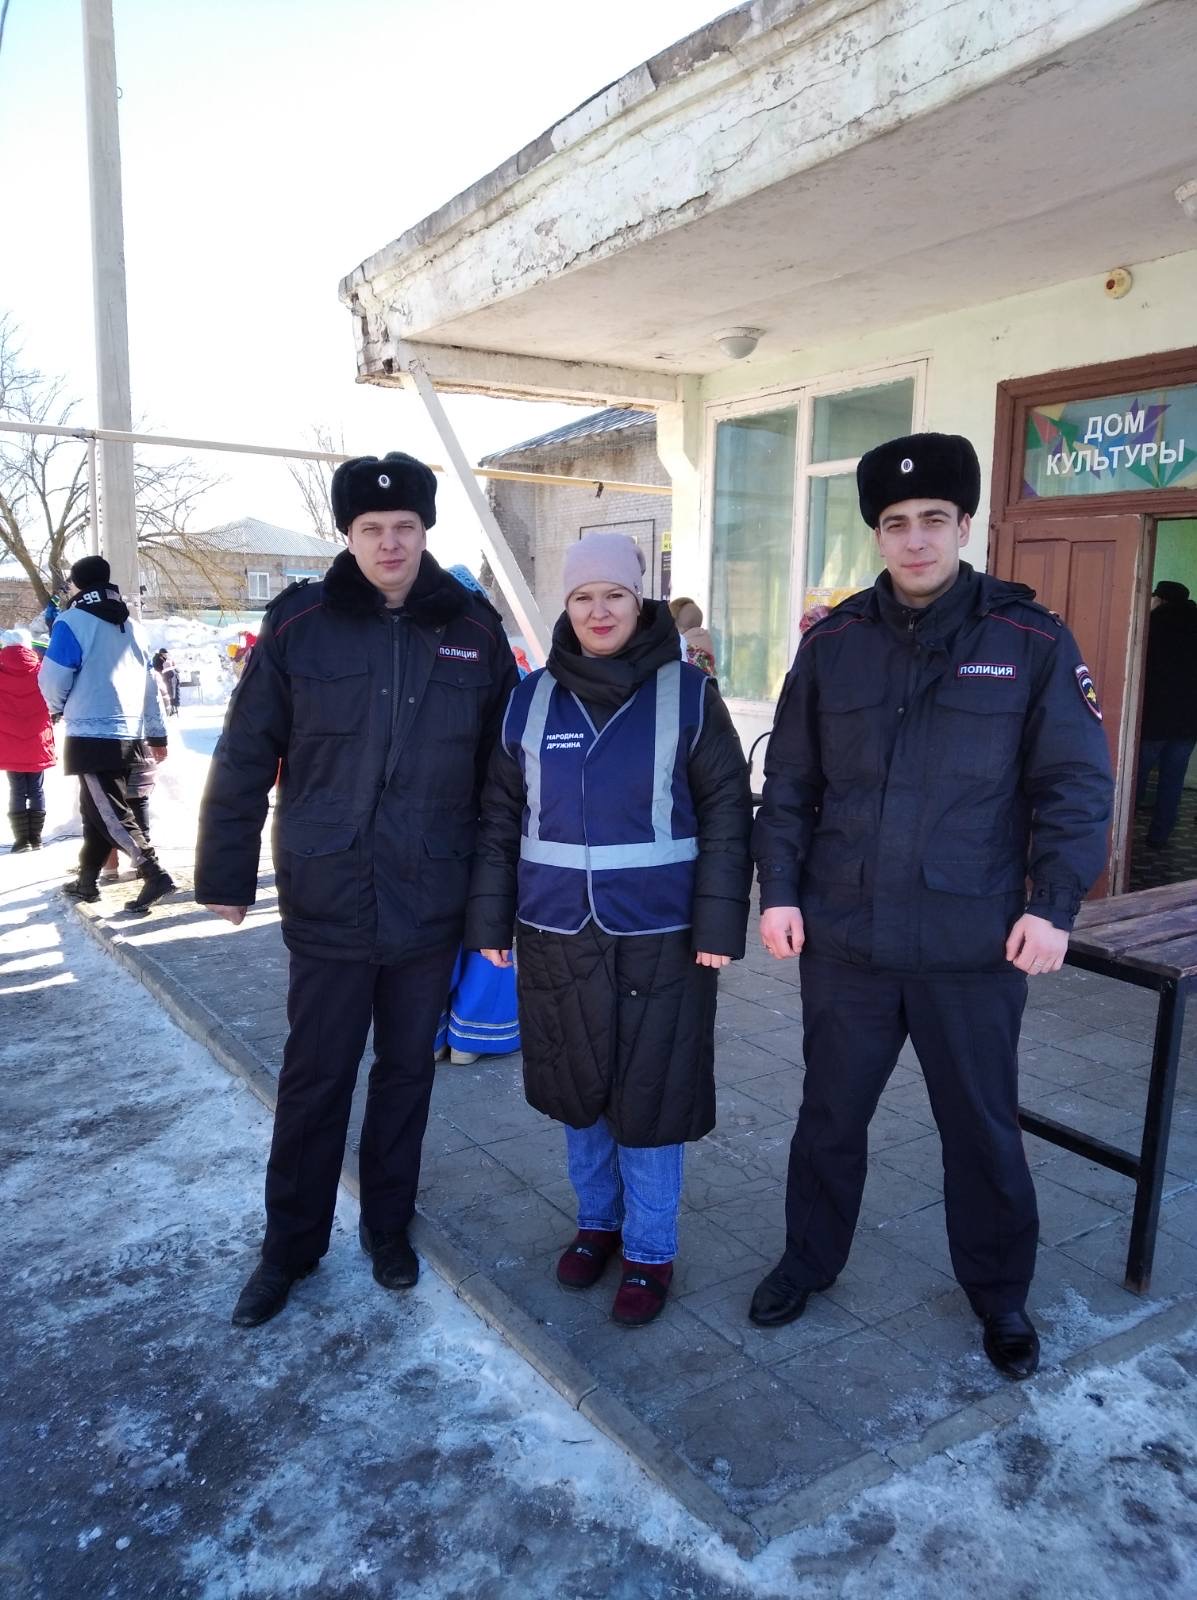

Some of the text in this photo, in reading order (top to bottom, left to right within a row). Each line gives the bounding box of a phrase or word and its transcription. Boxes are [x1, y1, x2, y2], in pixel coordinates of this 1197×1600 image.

[1084, 410, 1145, 443] ДОМ
[1046, 439, 1185, 476] КУЛЬТУРЫ
[439, 647, 478, 659] ПОЛИЦИЯ
[959, 665, 1013, 676] ПОЛИЦИЯ
[546, 733, 584, 741] НАРОДНАЯ
[546, 741, 581, 750] ДРУЖИНА
